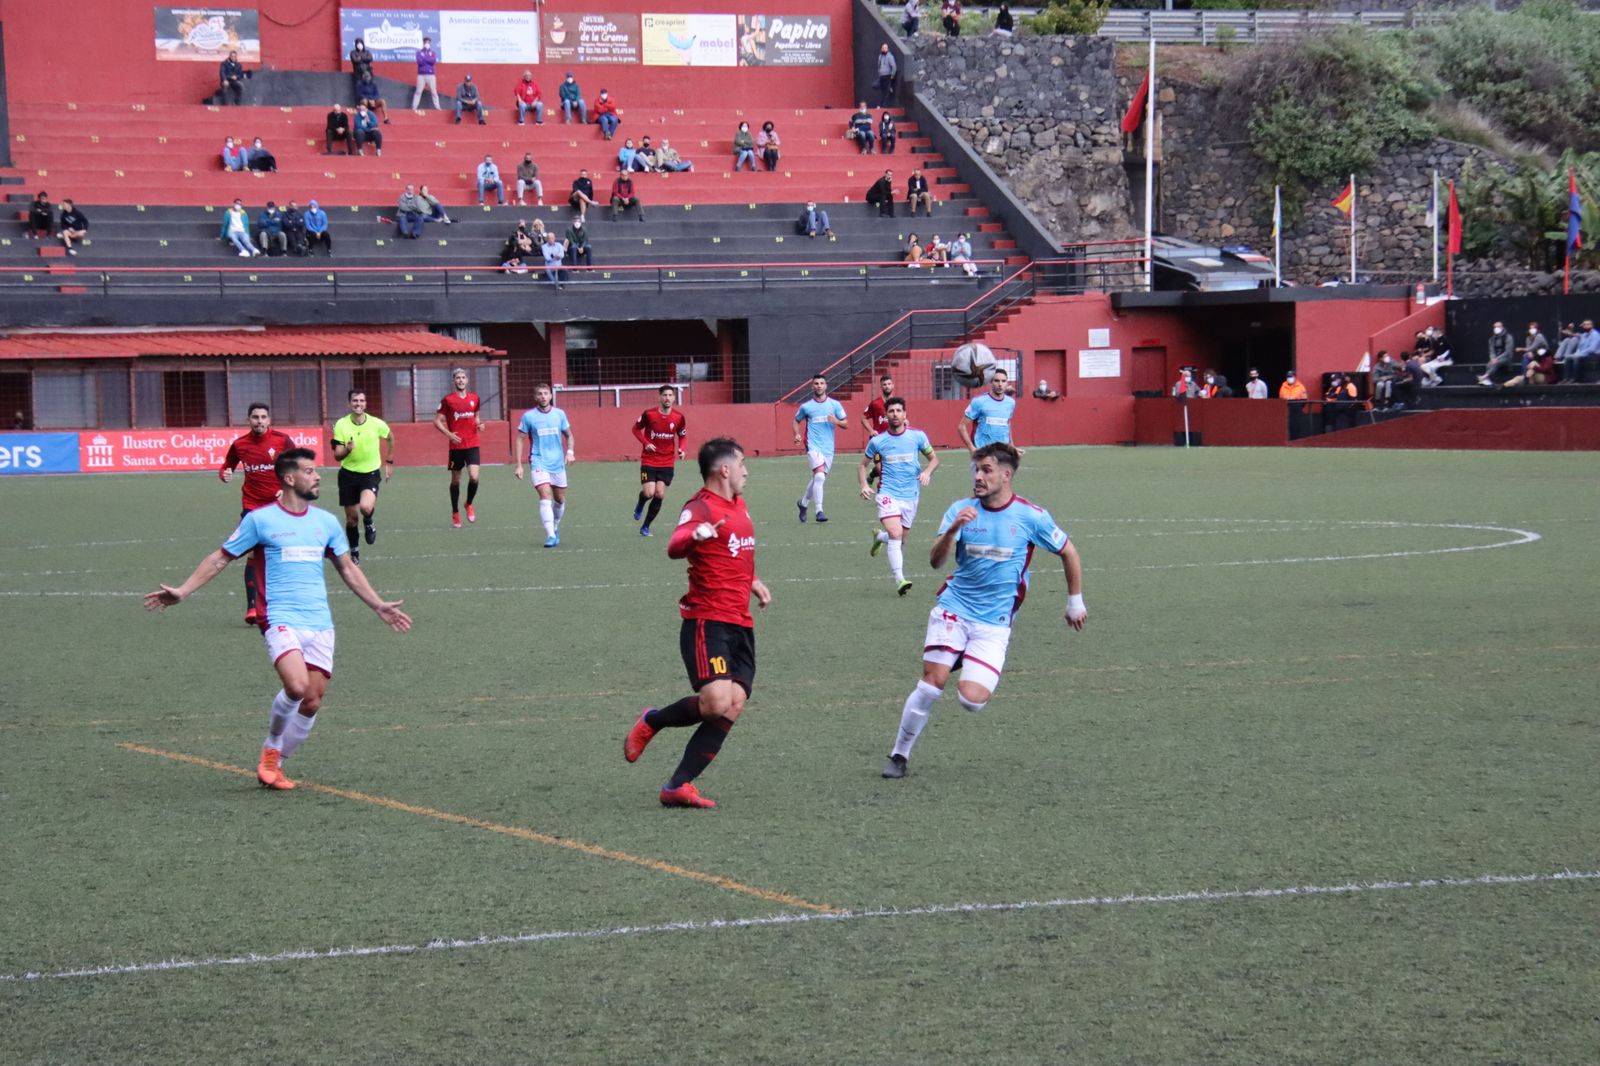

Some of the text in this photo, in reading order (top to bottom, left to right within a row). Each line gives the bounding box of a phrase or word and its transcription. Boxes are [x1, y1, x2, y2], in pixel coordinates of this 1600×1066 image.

[482, 16, 505, 24] Carlos
[507, 17, 529, 25] Matos
[655, 17, 685, 26] creaprint
[579, 21, 617, 32] Rinconcito
[768, 18, 828, 44] Papiro
[580, 31, 628, 42] de la Grama
[700, 37, 734, 48] mabel
[123, 435, 167, 449] Ilustre
[170, 433, 225, 452] Colegio
[123, 452, 225, 466] Santa Cruz de La
[709, 656, 727, 674] 10
